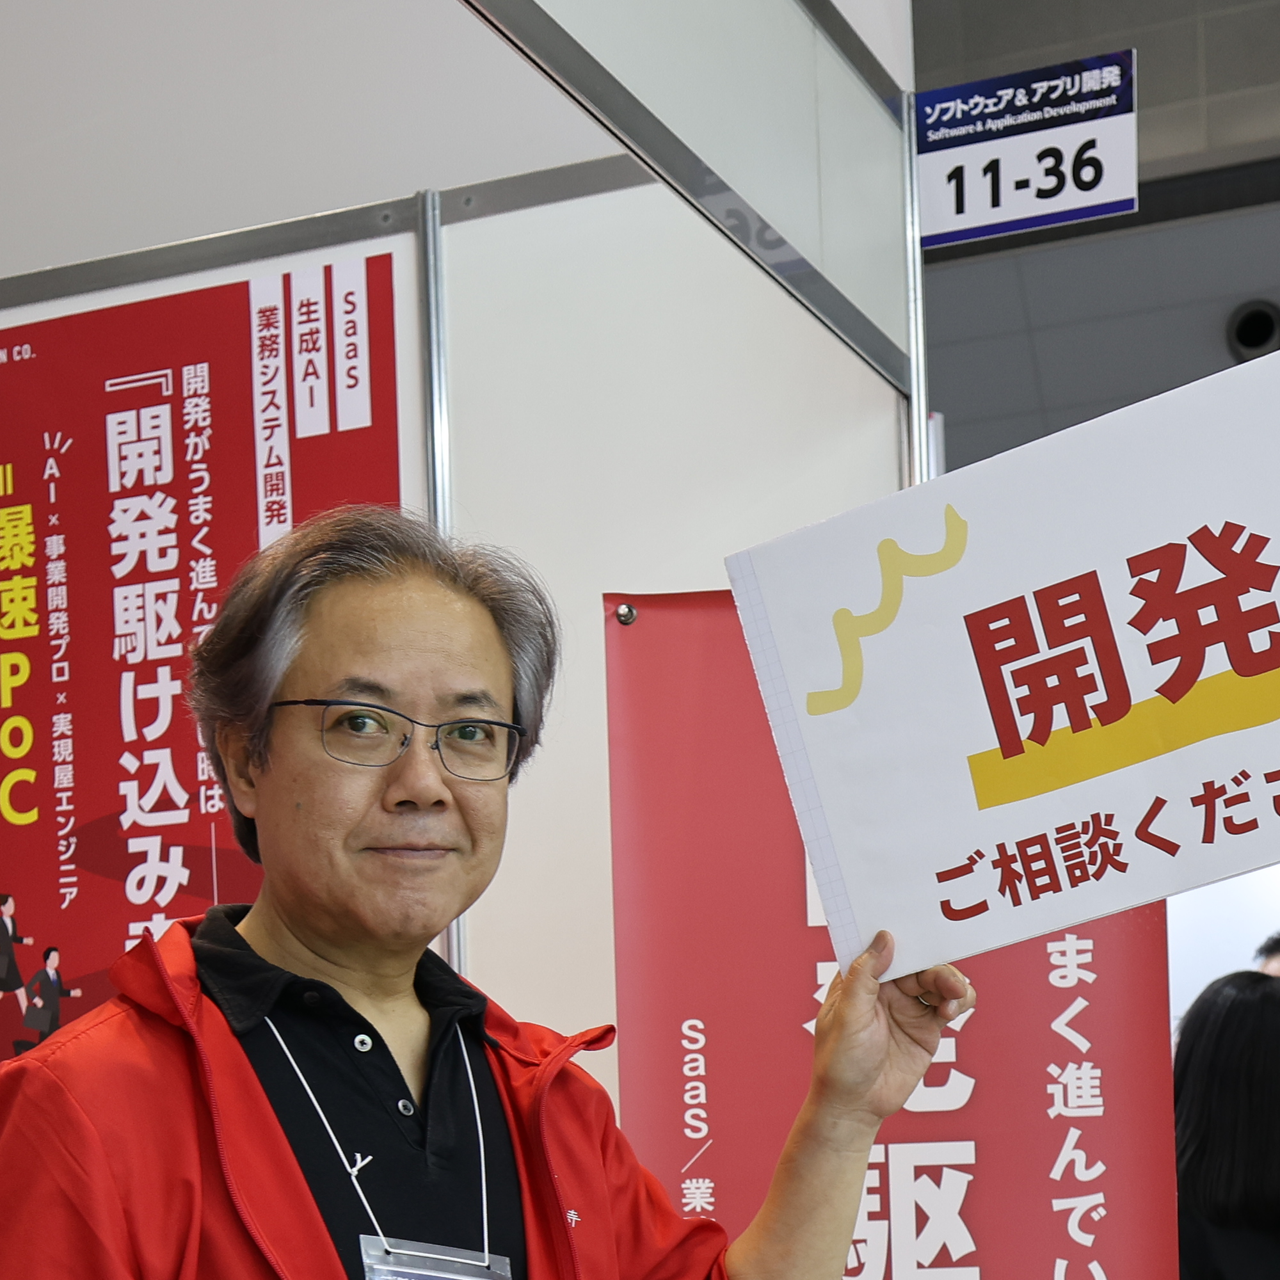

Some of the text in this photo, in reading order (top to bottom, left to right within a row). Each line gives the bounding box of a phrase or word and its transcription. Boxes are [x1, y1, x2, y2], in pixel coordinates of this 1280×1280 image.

[926, 94, 1118, 142] Software & Application Development
[947, 138, 1104, 215] 11-36
[12, 343, 37, 365] CO.
[296, 298, 322, 411] 生成AI
[342, 289, 361, 392] SaaS
[255, 303, 289, 527] 業務システム開発
